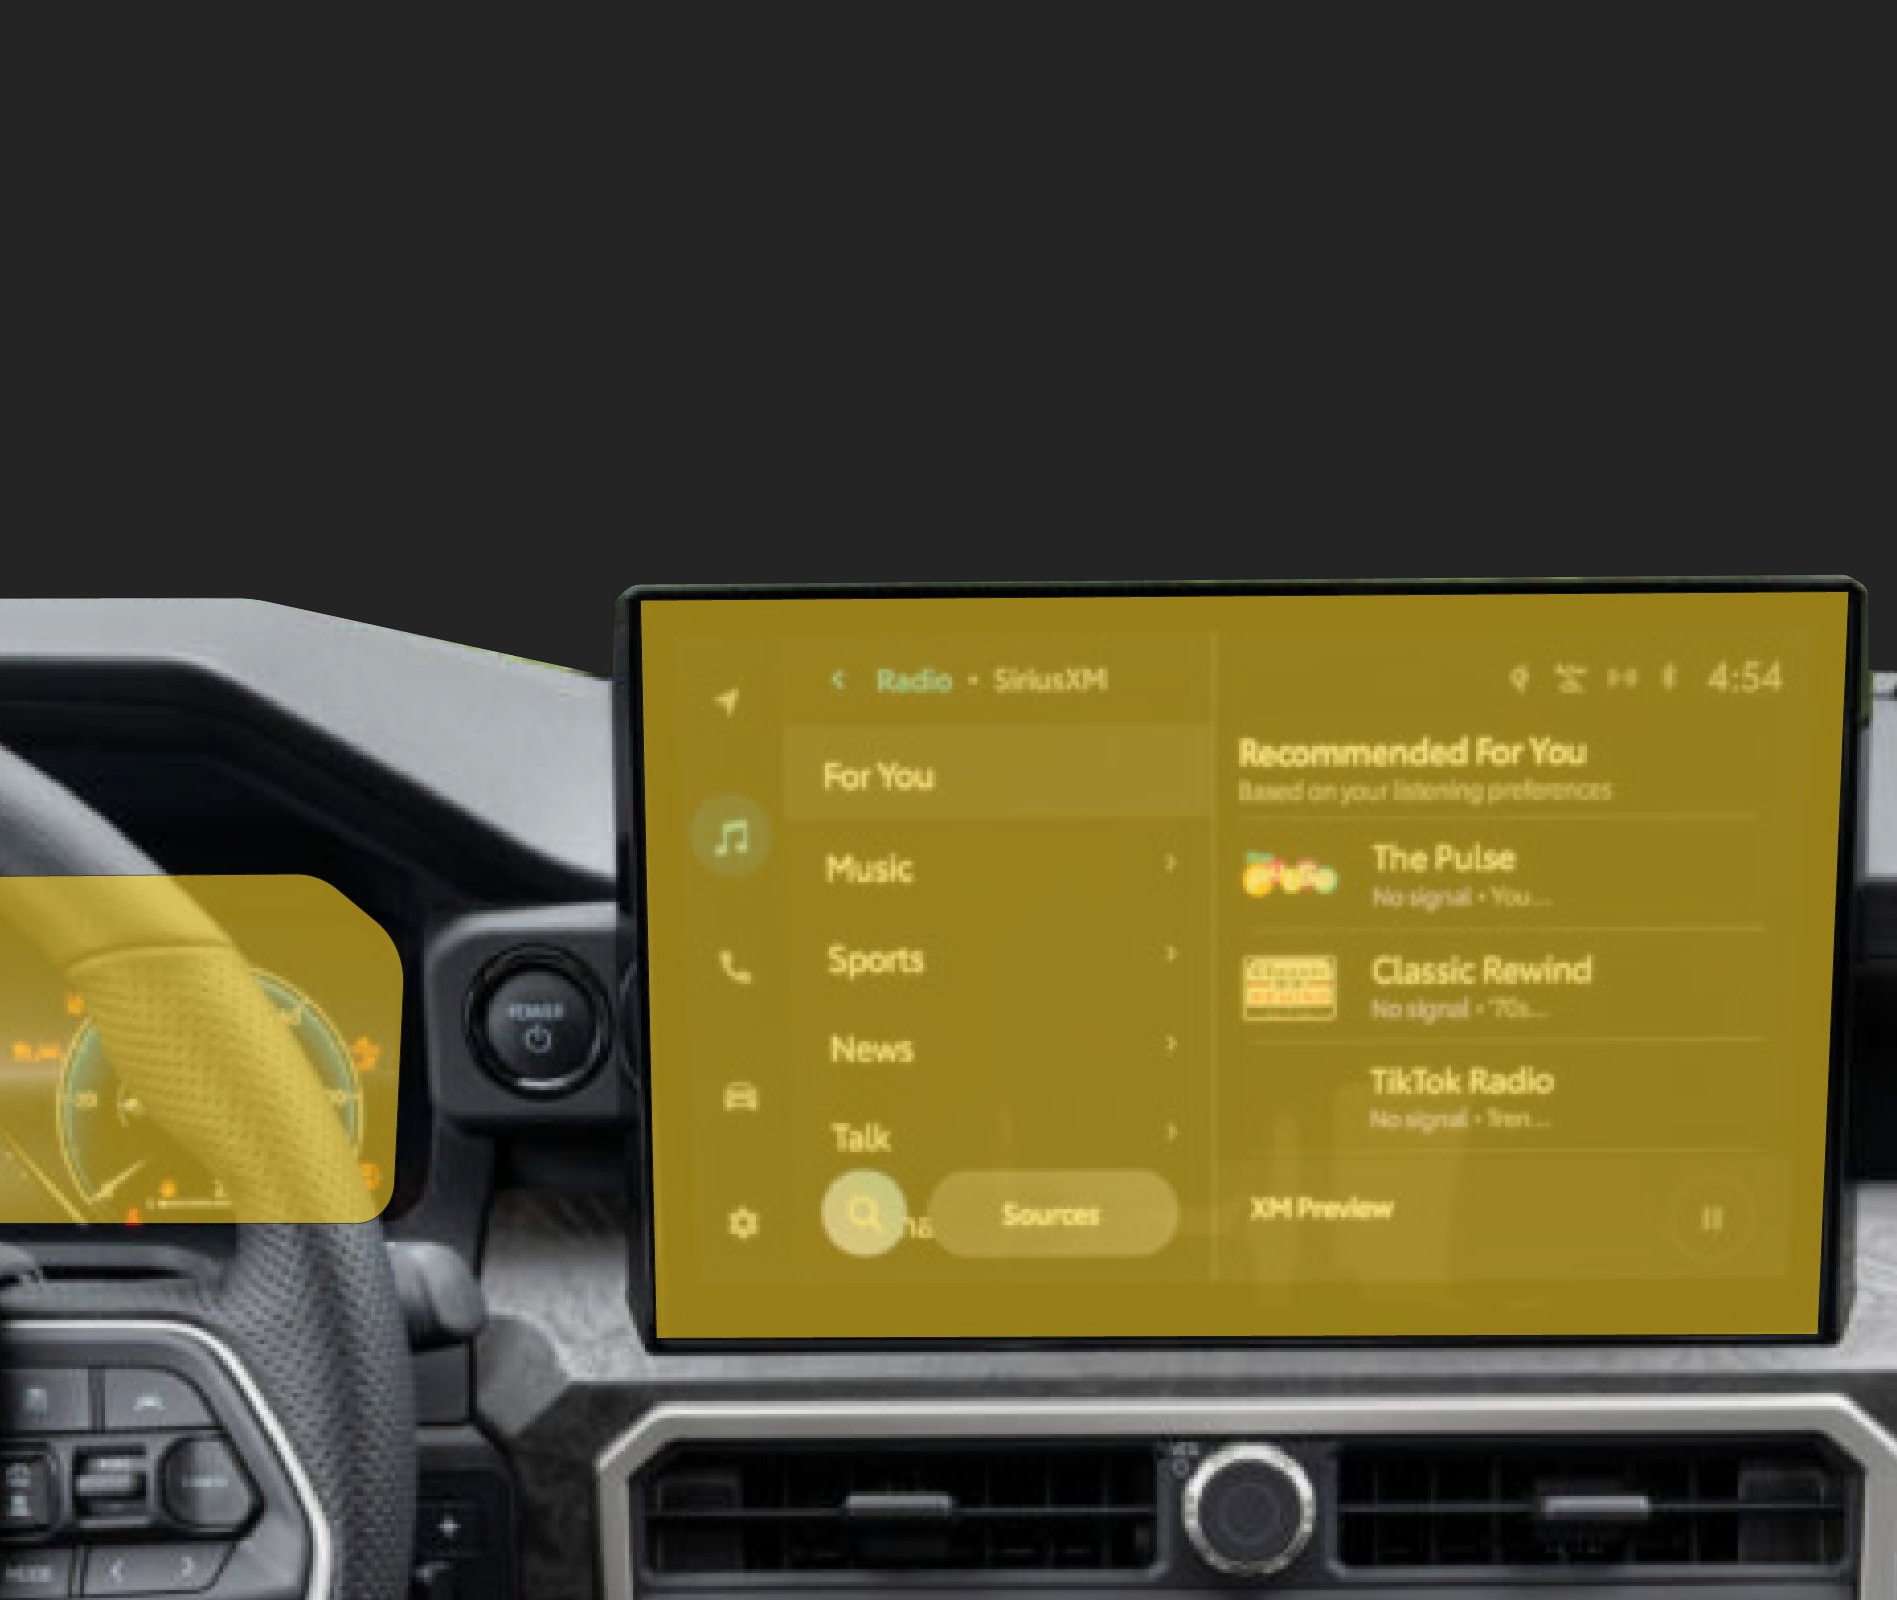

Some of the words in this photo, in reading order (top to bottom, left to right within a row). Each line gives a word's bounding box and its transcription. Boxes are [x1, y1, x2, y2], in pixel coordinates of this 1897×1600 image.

[876, 667, 953, 693] Radio
[992, 667, 1109, 694] SiriusXM
[1706, 660, 1784, 692] 4:54
[1238, 735, 1469, 768] Recommended
[1475, 735, 1526, 768] For
[1528, 735, 1588, 768] You
[824, 761, 871, 792] For
[877, 761, 936, 792] You
[824, 852, 914, 883] Music
[1371, 842, 1429, 874] The
[1434, 841, 1518, 874] Pulse
[1373, 885, 1403, 908] No
[1409, 885, 1473, 913] signal
[828, 942, 924, 981] Sports
[1371, 954, 1477, 987] Classic
[1482, 954, 1592, 985] Rewind
[1369, 999, 1403, 1020] No
[1405, 995, 1471, 1026] signal
[830, 1034, 916, 1063] News
[1369, 1065, 1461, 1095] TikTok
[1467, 1065, 1555, 1095] Radio
[831, 1122, 892, 1153] Talk
[1369, 1110, 1403, 1130] No
[1405, 1109, 1469, 1136] signal
[1002, 1200, 1102, 1226] Sources
[1250, 1196, 1293, 1220] XM
[1295, 1196, 1395, 1220] Preview
